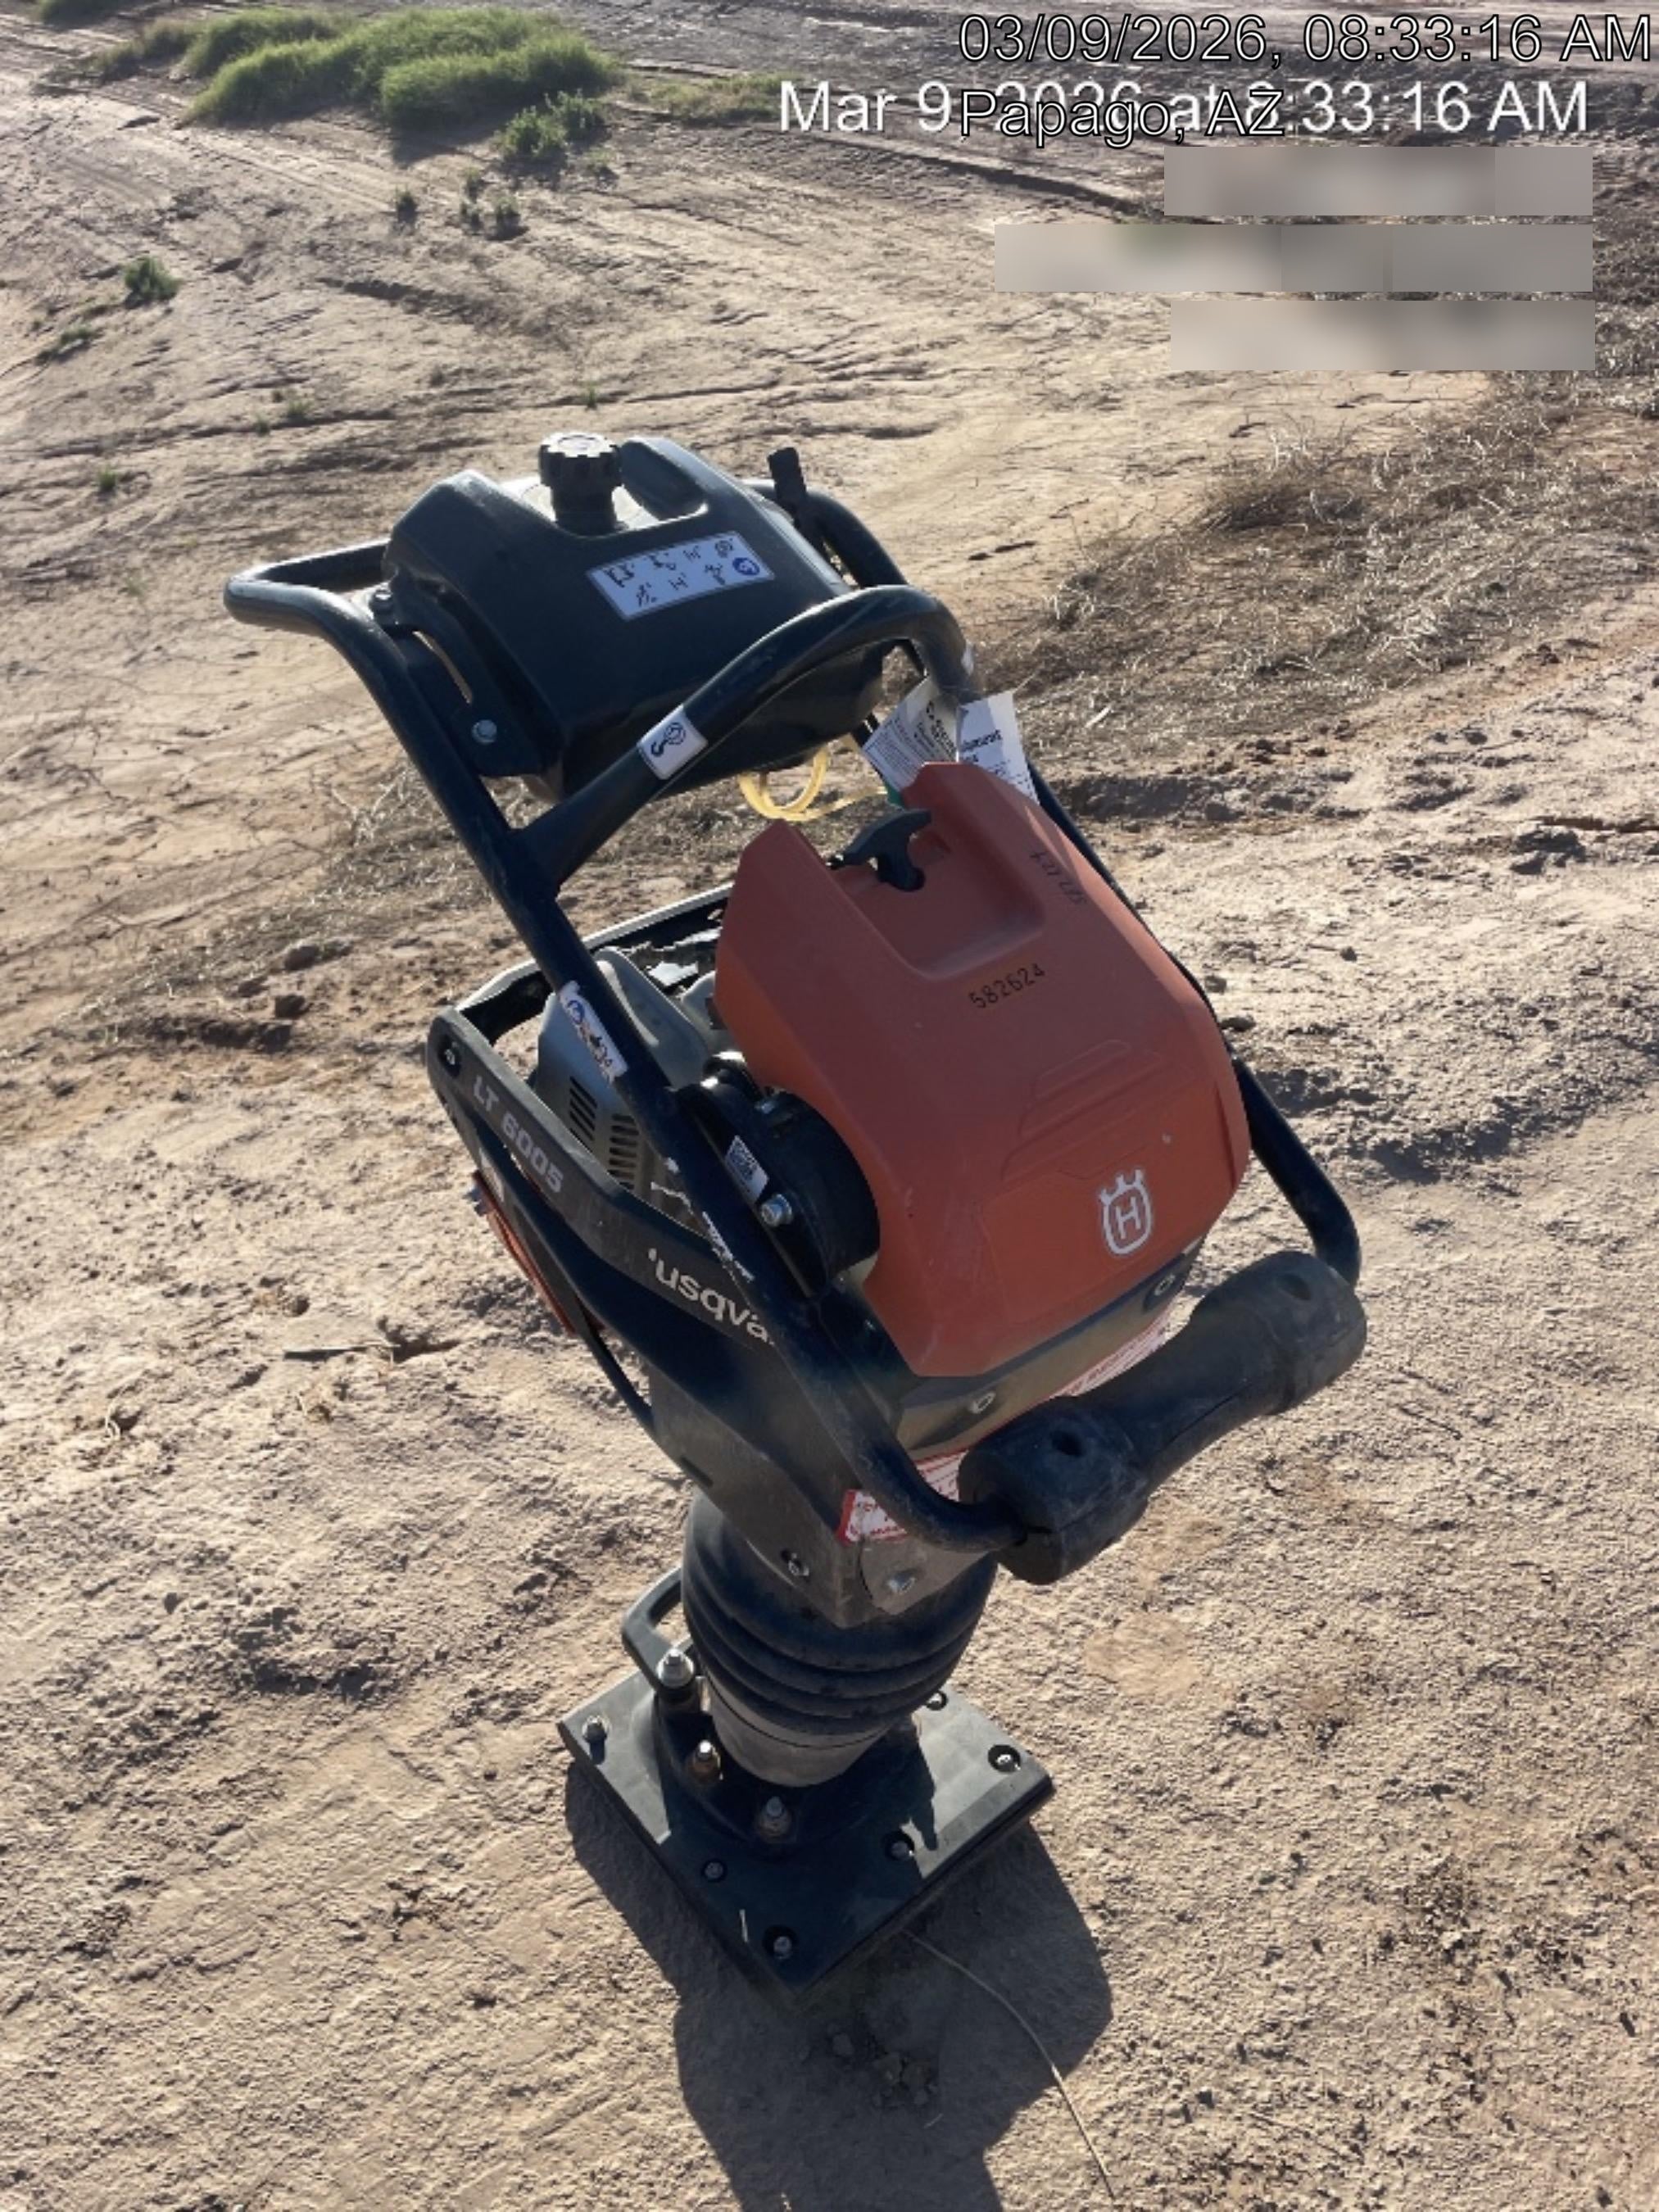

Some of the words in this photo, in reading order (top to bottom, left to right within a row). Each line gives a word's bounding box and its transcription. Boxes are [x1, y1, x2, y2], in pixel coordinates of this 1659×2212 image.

[474, 1075, 499, 1112] LT
[501, 1111, 564, 1194] 6005
[647, 1247, 775, 1346] usqva
